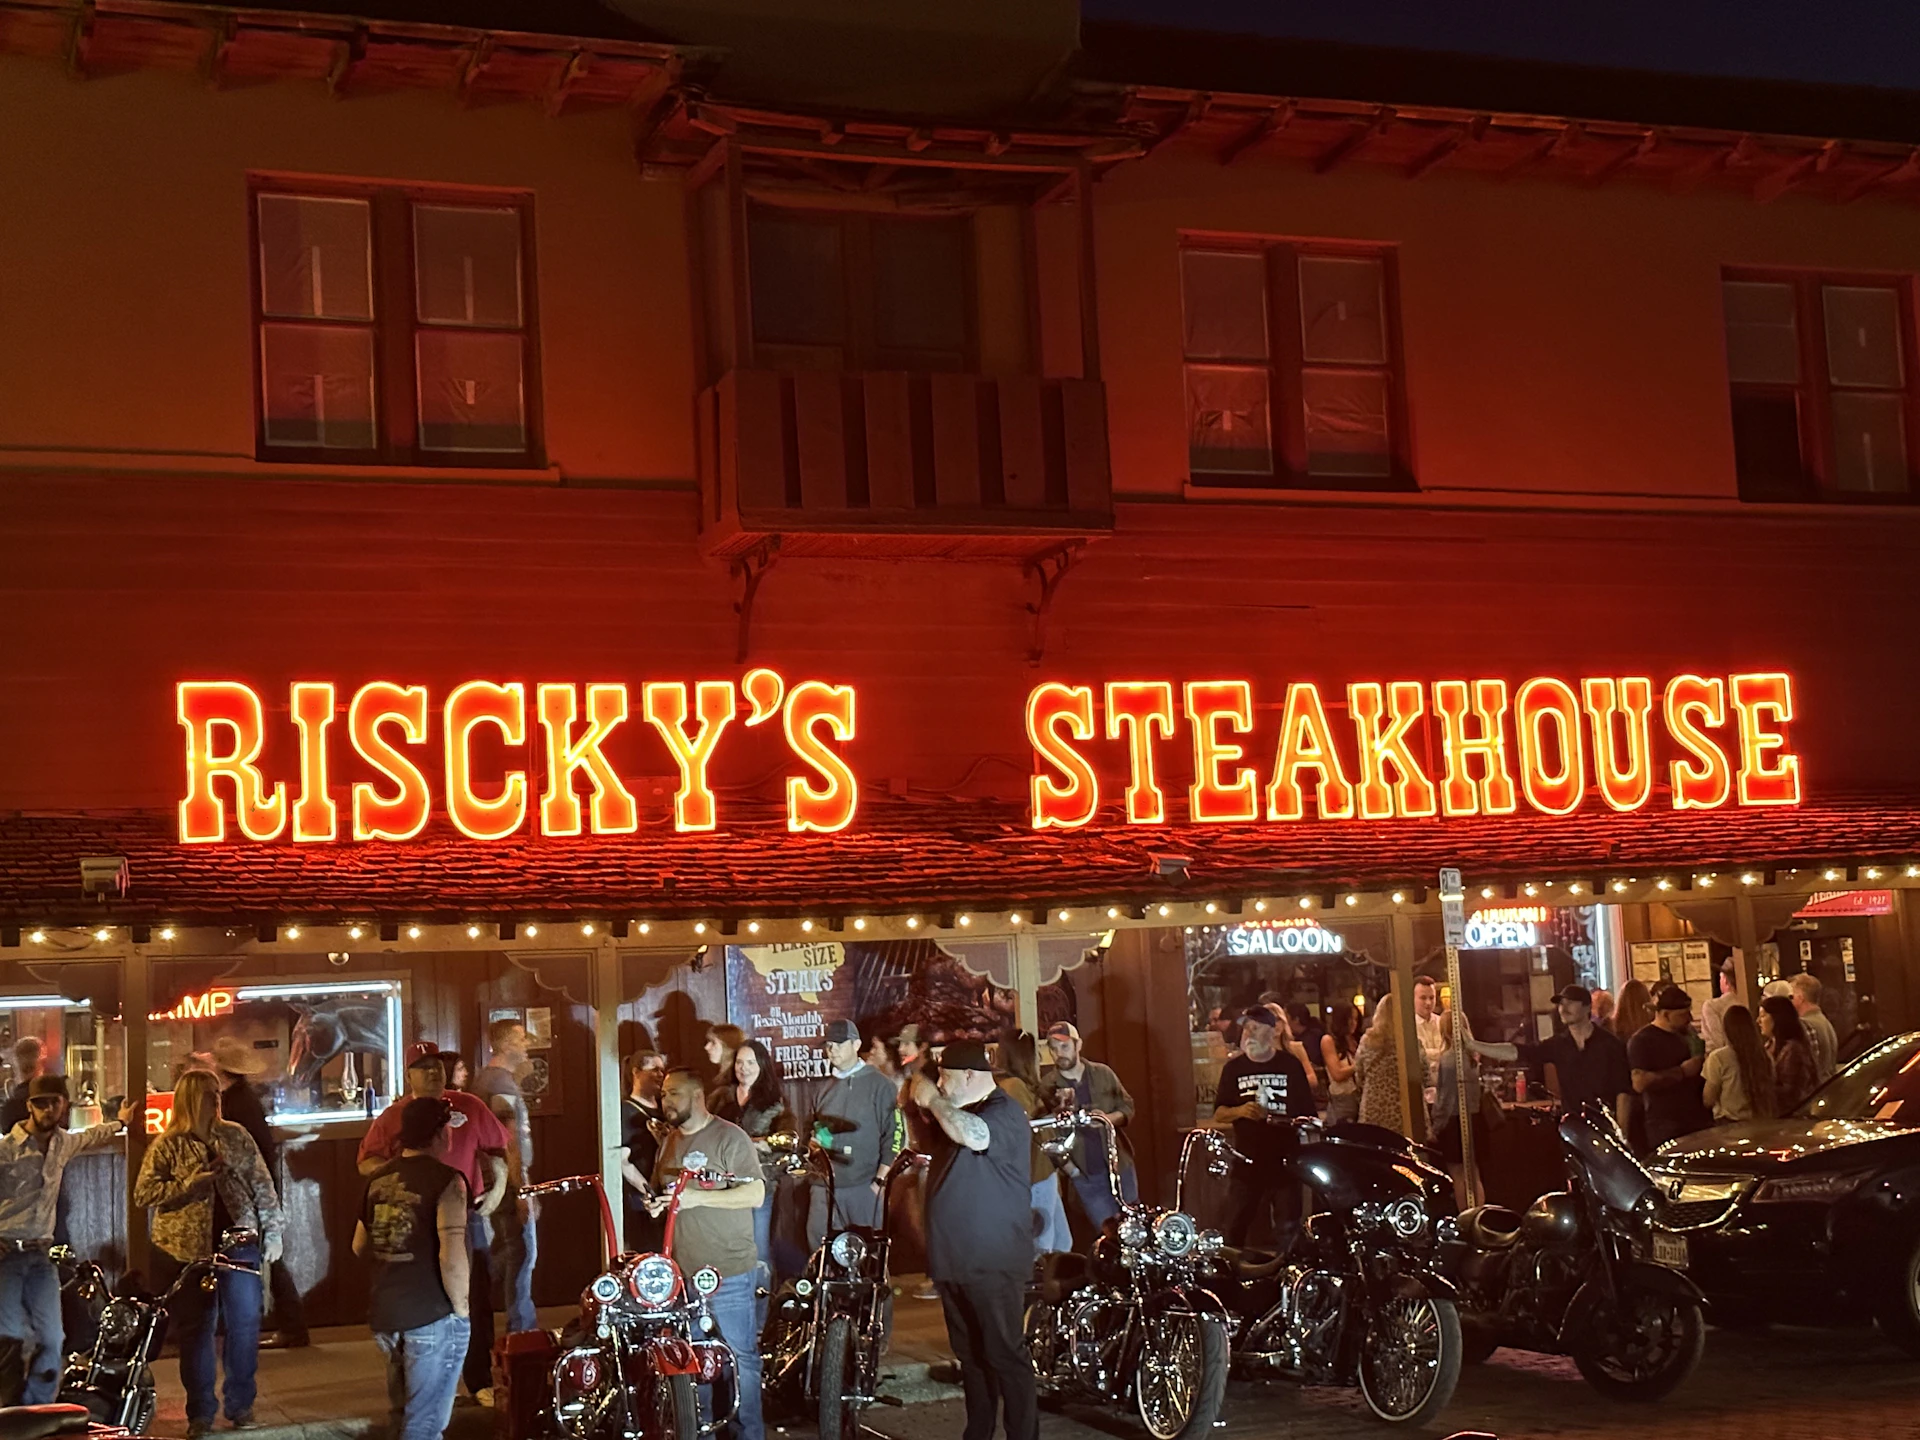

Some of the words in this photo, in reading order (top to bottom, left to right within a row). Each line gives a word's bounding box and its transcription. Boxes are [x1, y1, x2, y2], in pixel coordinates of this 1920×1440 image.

[175, 667, 859, 845] RISCKY'S
[1025, 671, 1801, 830] STEAKHOUSE
[1231, 926, 1343, 955] SALOON
[1464, 920, 1537, 949] OPEN
[802, 944, 838, 968] SIZE
[764, 969, 834, 995] STEAKS
[782, 1024, 818, 1040] BUCKET
[775, 1044, 810, 1062] FRIES
